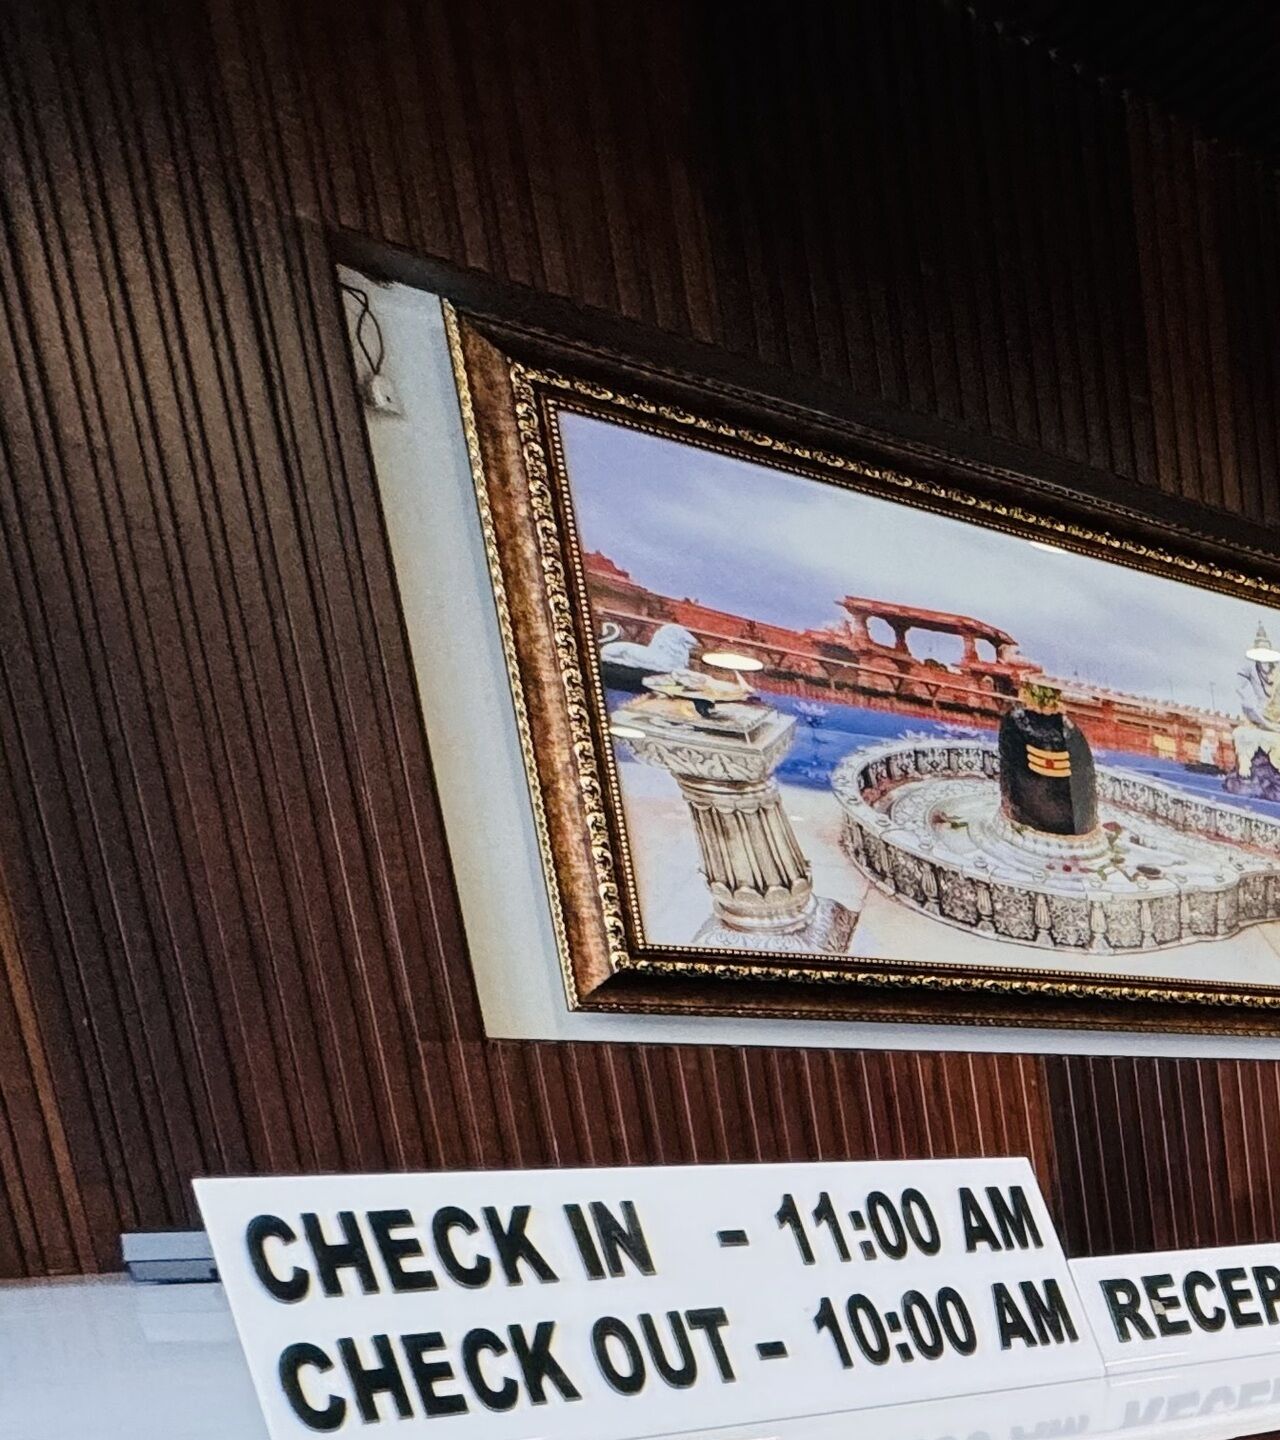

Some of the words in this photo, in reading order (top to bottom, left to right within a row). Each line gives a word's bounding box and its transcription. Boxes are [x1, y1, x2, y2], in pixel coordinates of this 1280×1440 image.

[245, 1204, 560, 1304] CHECK
[563, 1200, 657, 1281] IN
[776, 1187, 941, 1265] 11:00
[958, 1185, 1045, 1253] AM
[278, 1320, 583, 1433] CHECK
[592, 1307, 735, 1396] OUT
[813, 1286, 978, 1369] 10:00
[992, 1278, 1079, 1350] AM
